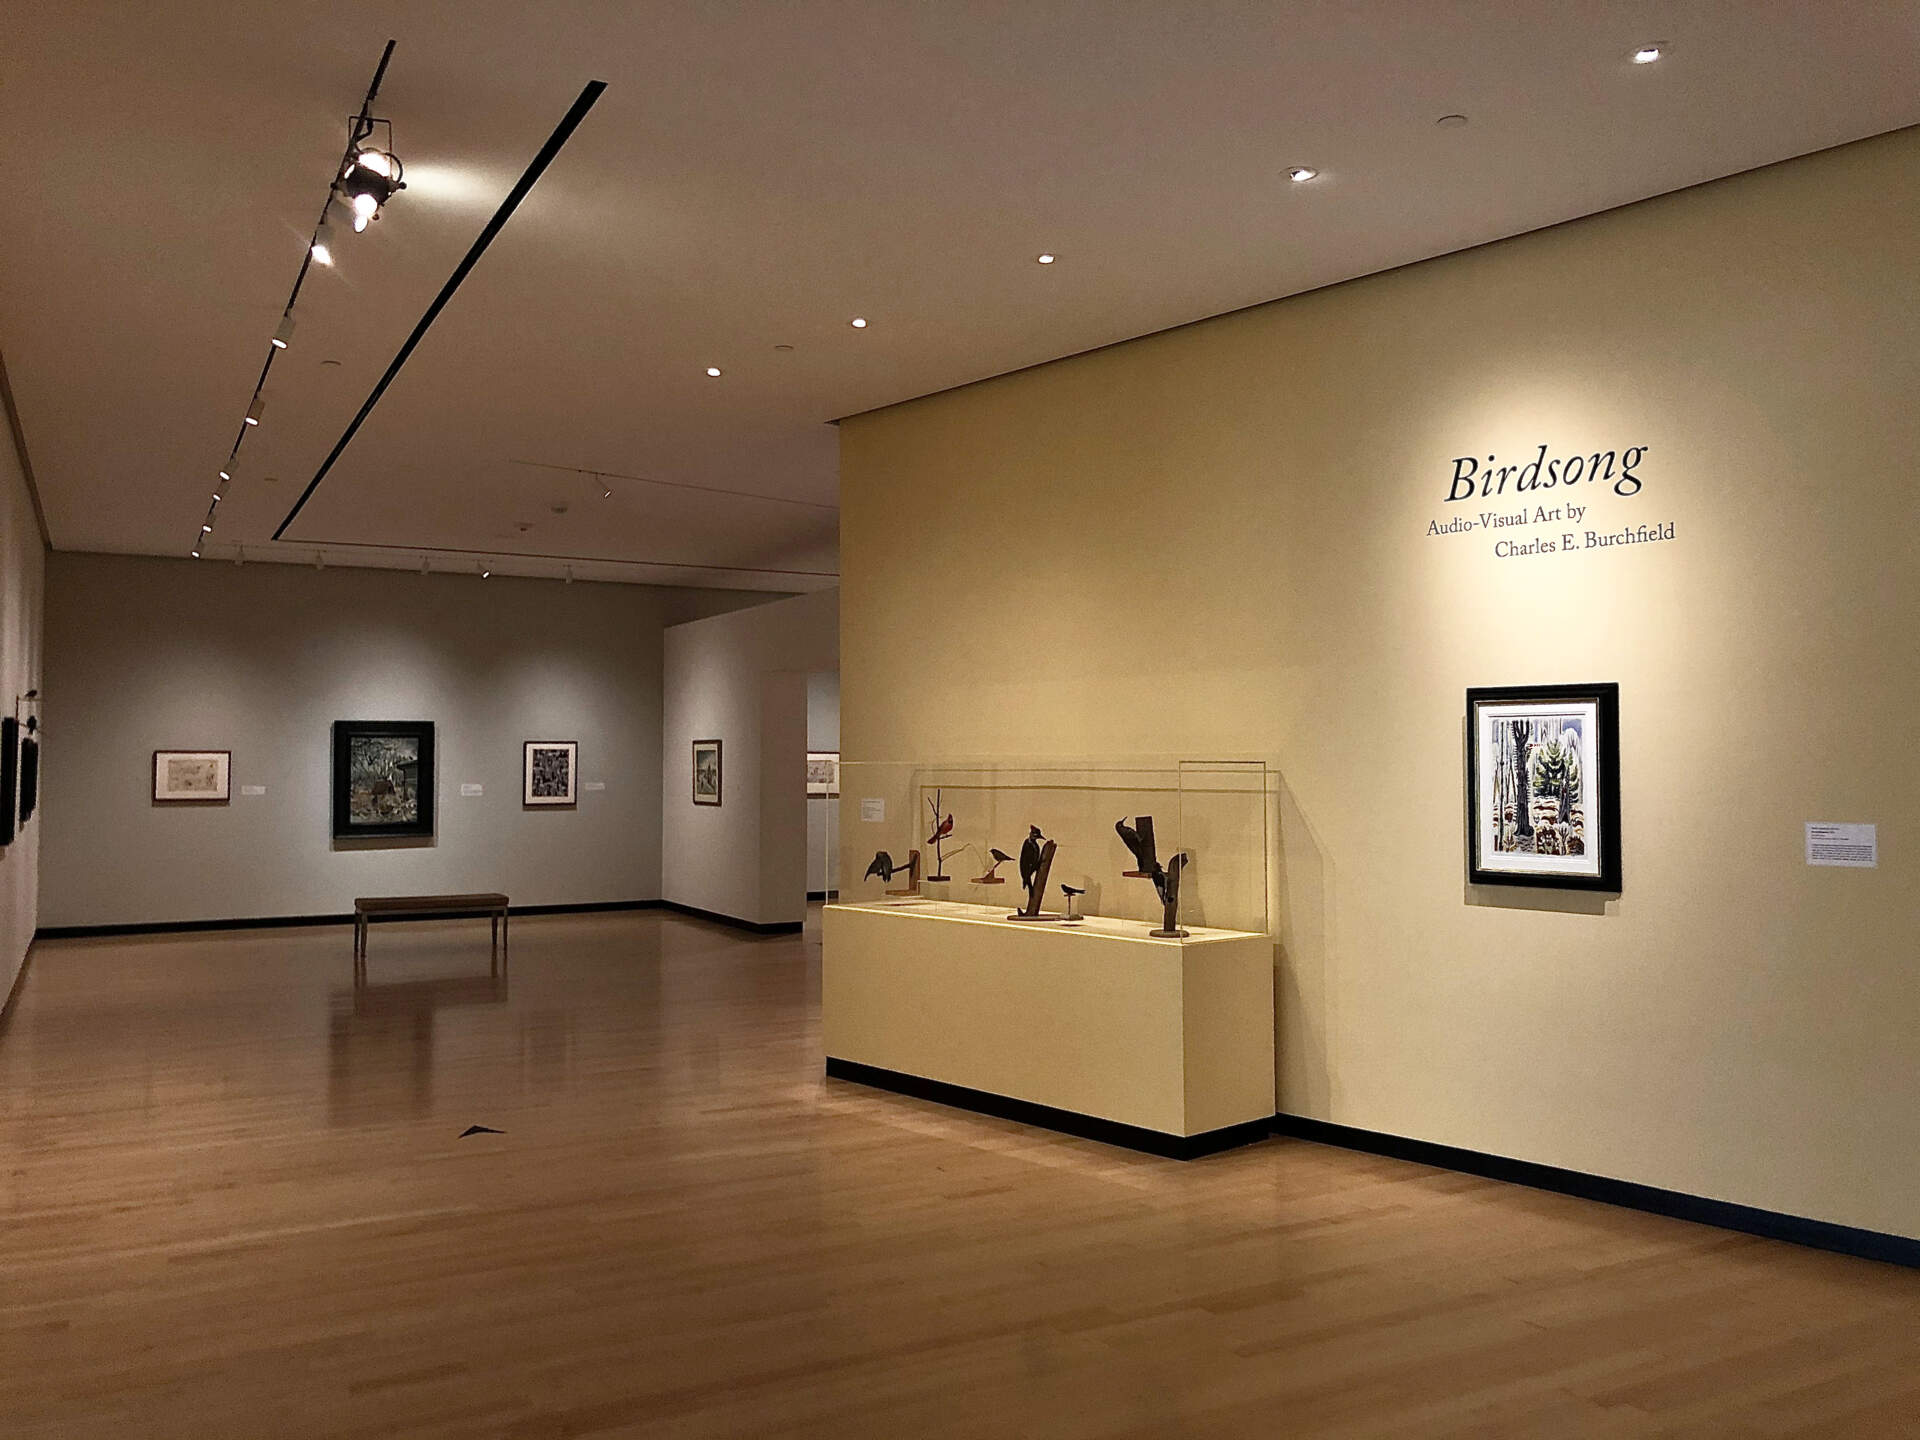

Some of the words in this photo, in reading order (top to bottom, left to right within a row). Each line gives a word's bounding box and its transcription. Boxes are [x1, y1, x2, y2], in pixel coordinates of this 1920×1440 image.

[1443, 444, 1649, 502] Birdsong
[1426, 508, 1528, 537] Audio-Visual
[1533, 505, 1562, 523] Art
[1566, 502, 1587, 523] by
[1494, 537, 1556, 558] Charles
[1561, 533, 1580, 552] E.
[1585, 521, 1676, 549] Burchfield
